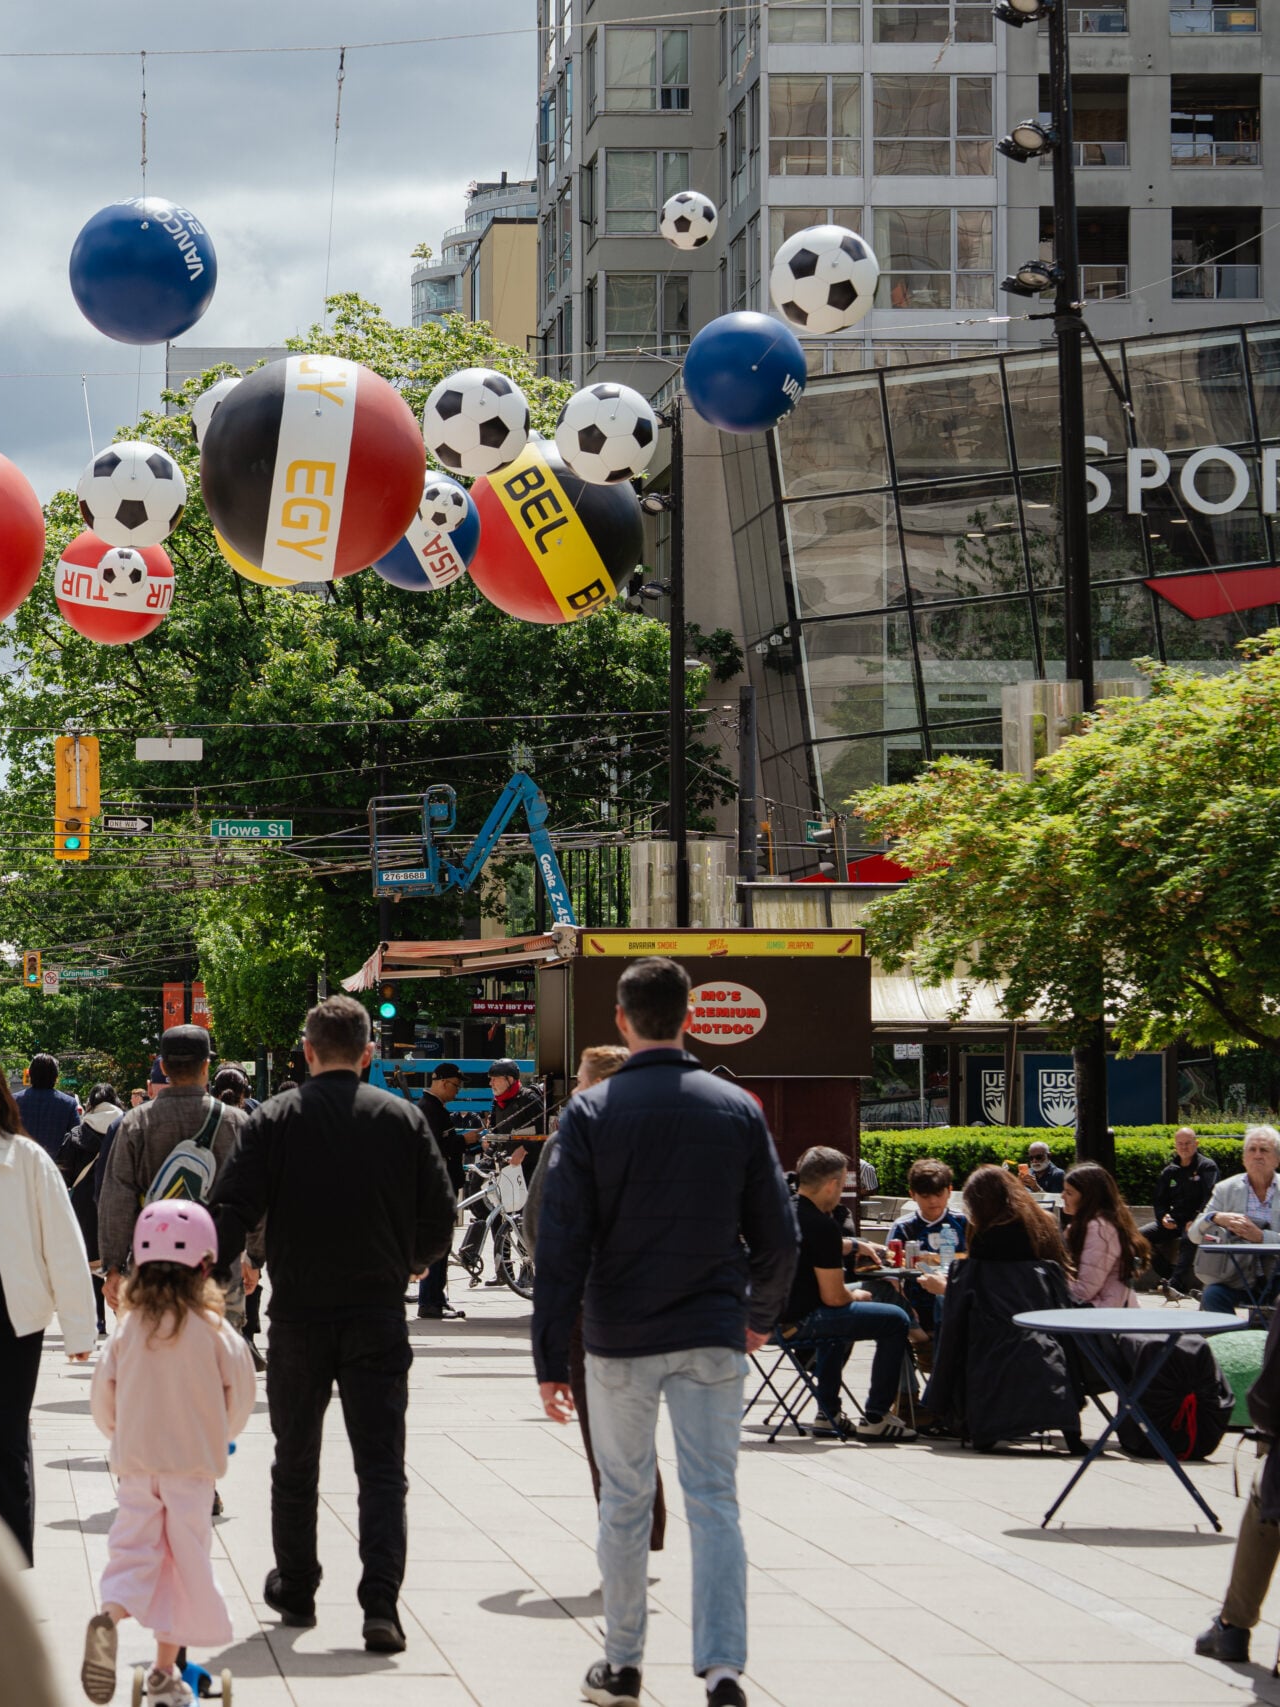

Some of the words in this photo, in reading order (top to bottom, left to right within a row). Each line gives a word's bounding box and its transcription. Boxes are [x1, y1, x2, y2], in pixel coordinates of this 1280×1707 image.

[276, 459, 337, 562] EGY
[503, 465, 569, 555] BEL
[422, 532, 460, 584] USA
[61, 569, 109, 602] TUR
[109, 820, 122, 828] ONE
[124, 821, 138, 829] WAY
[218, 823, 261, 837] Howe
[267, 823, 285, 837] St
[539, 853, 557, 889] Genie
[62, 969, 94, 977] Granville
[700, 990, 742, 1002] MO'S
[694, 1006, 761, 1019] REMIUM
[690, 1023, 754, 1035] HOTDOG
[985, 1073, 1005, 1087] UB
